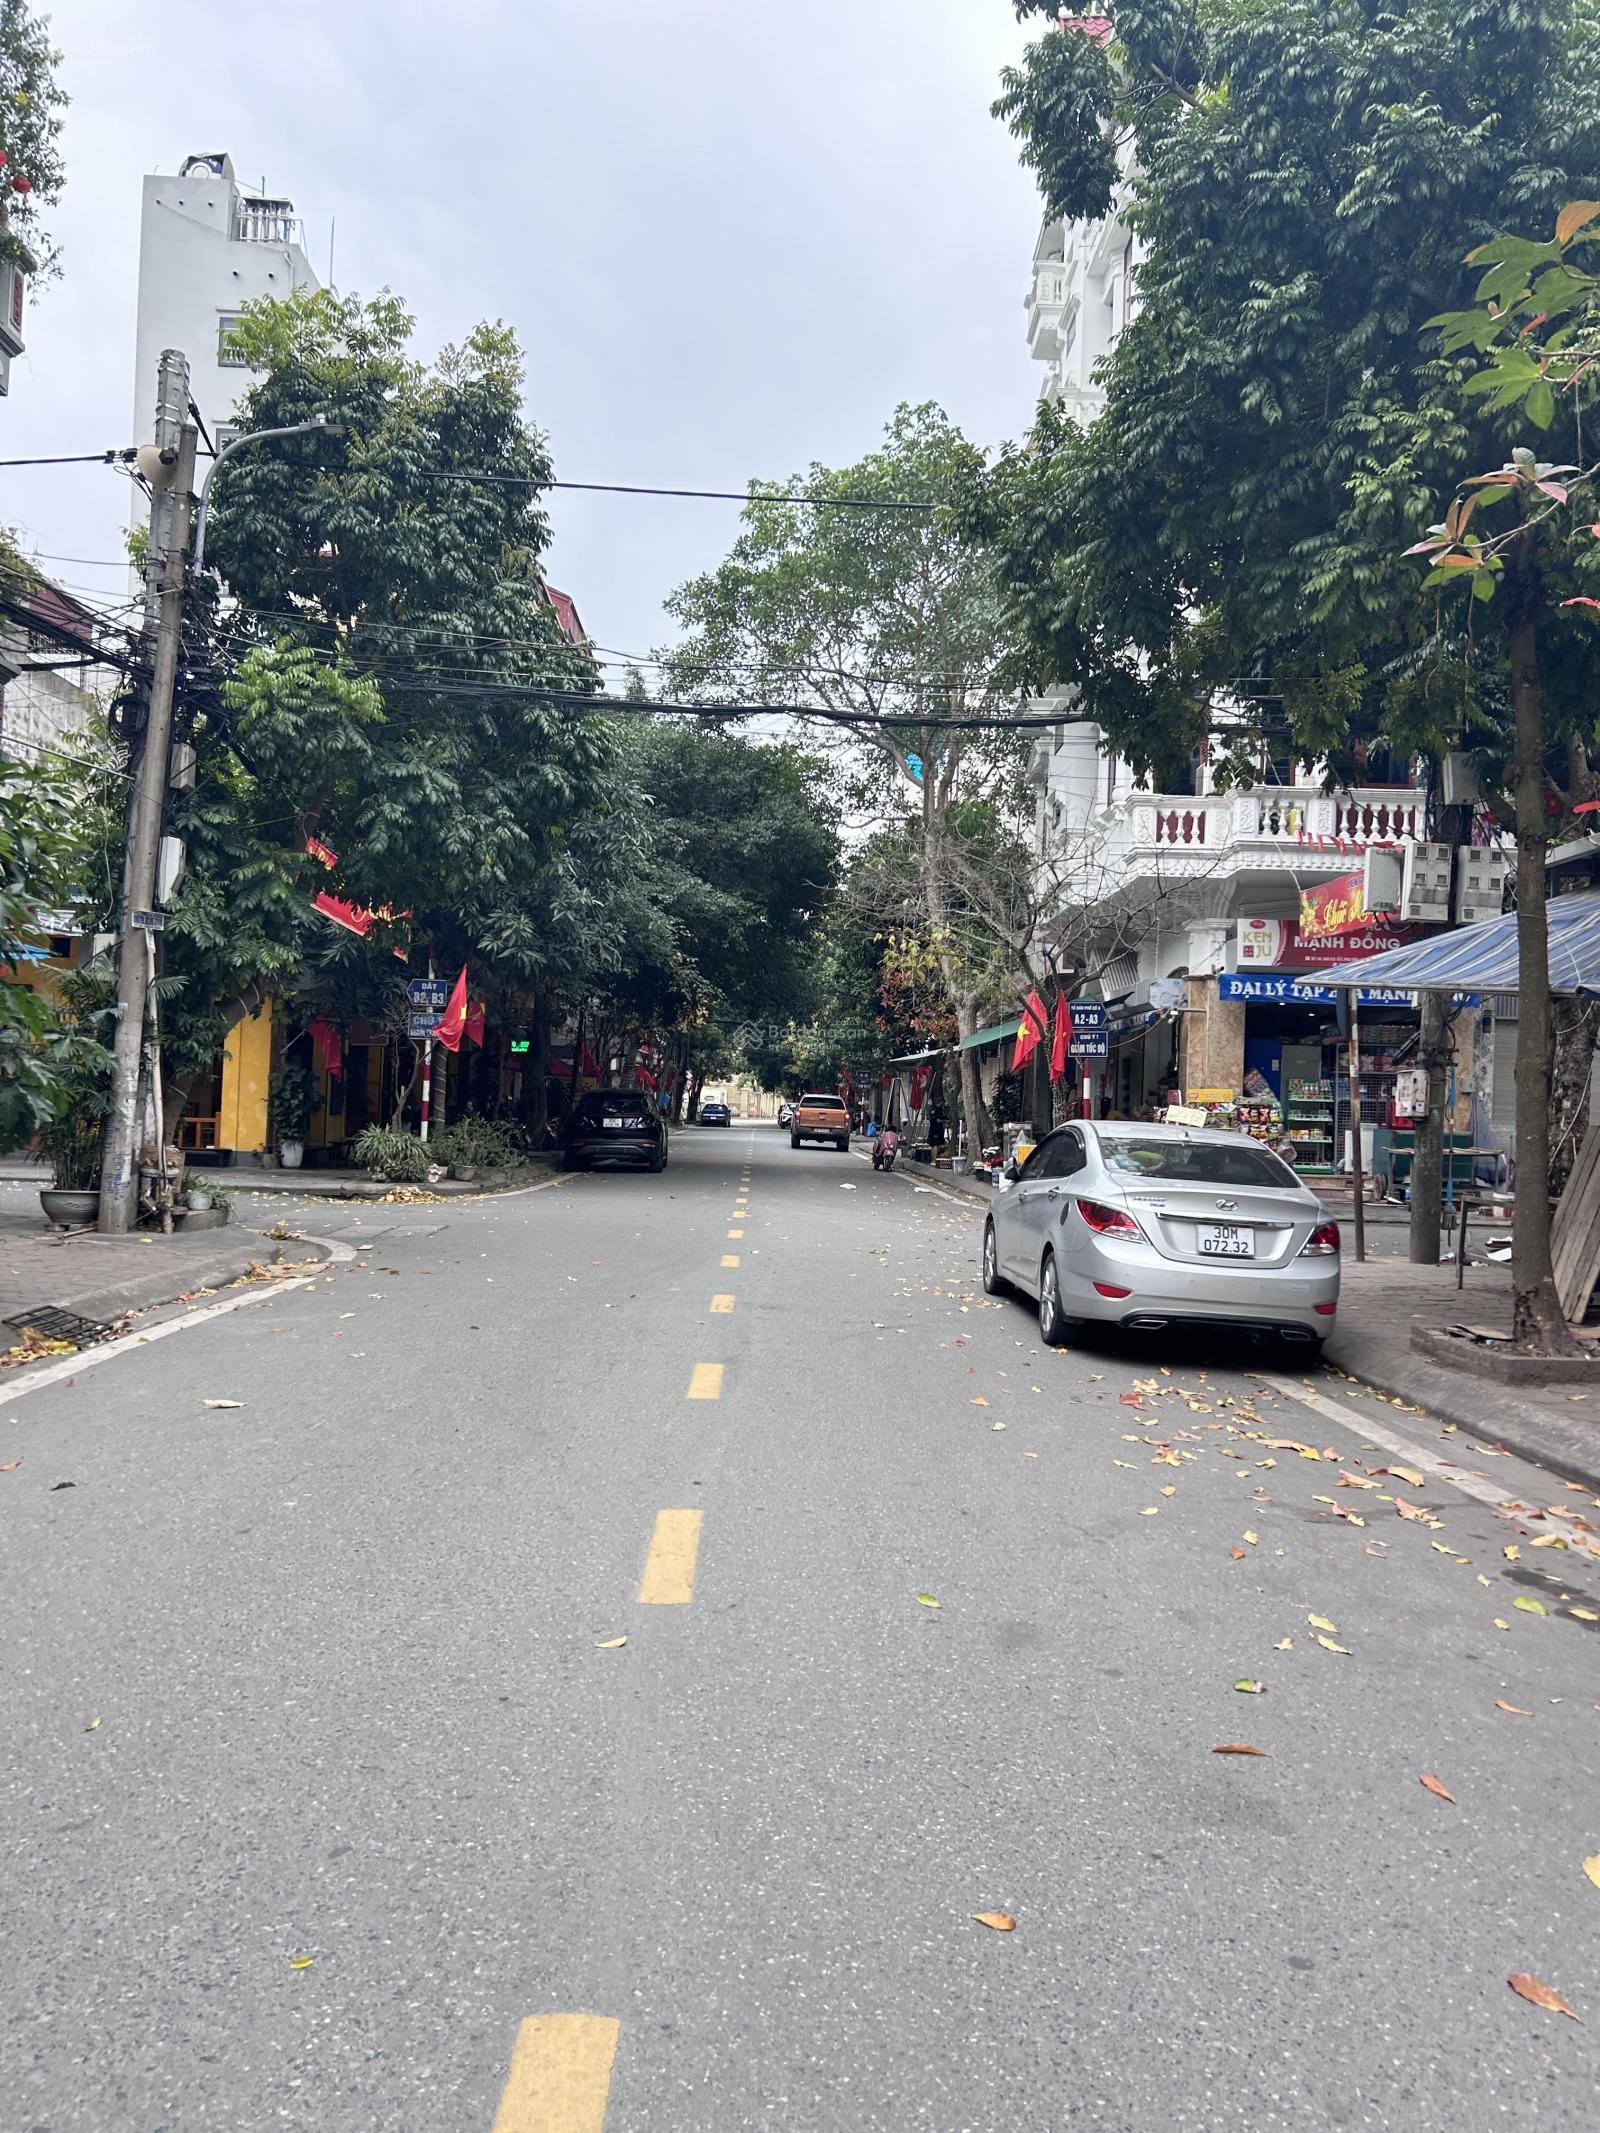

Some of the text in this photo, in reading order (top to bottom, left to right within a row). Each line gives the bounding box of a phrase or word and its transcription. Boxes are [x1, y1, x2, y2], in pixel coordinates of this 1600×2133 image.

[1243, 931, 1272, 943] KEN
[1349, 932, 1400, 950] ĐỒNG
[1229, 981, 1261, 998] ĐẠI
[1265, 980, 1287, 995] LÝ
[1291, 983, 1325, 1000] TẠP
[432, 993, 444, 1004] B3
[1086, 1042, 1097, 1053] TỐC
[1214, 1227, 1238, 1240] 30M
[1204, 1239, 1248, 1254] 072.32
